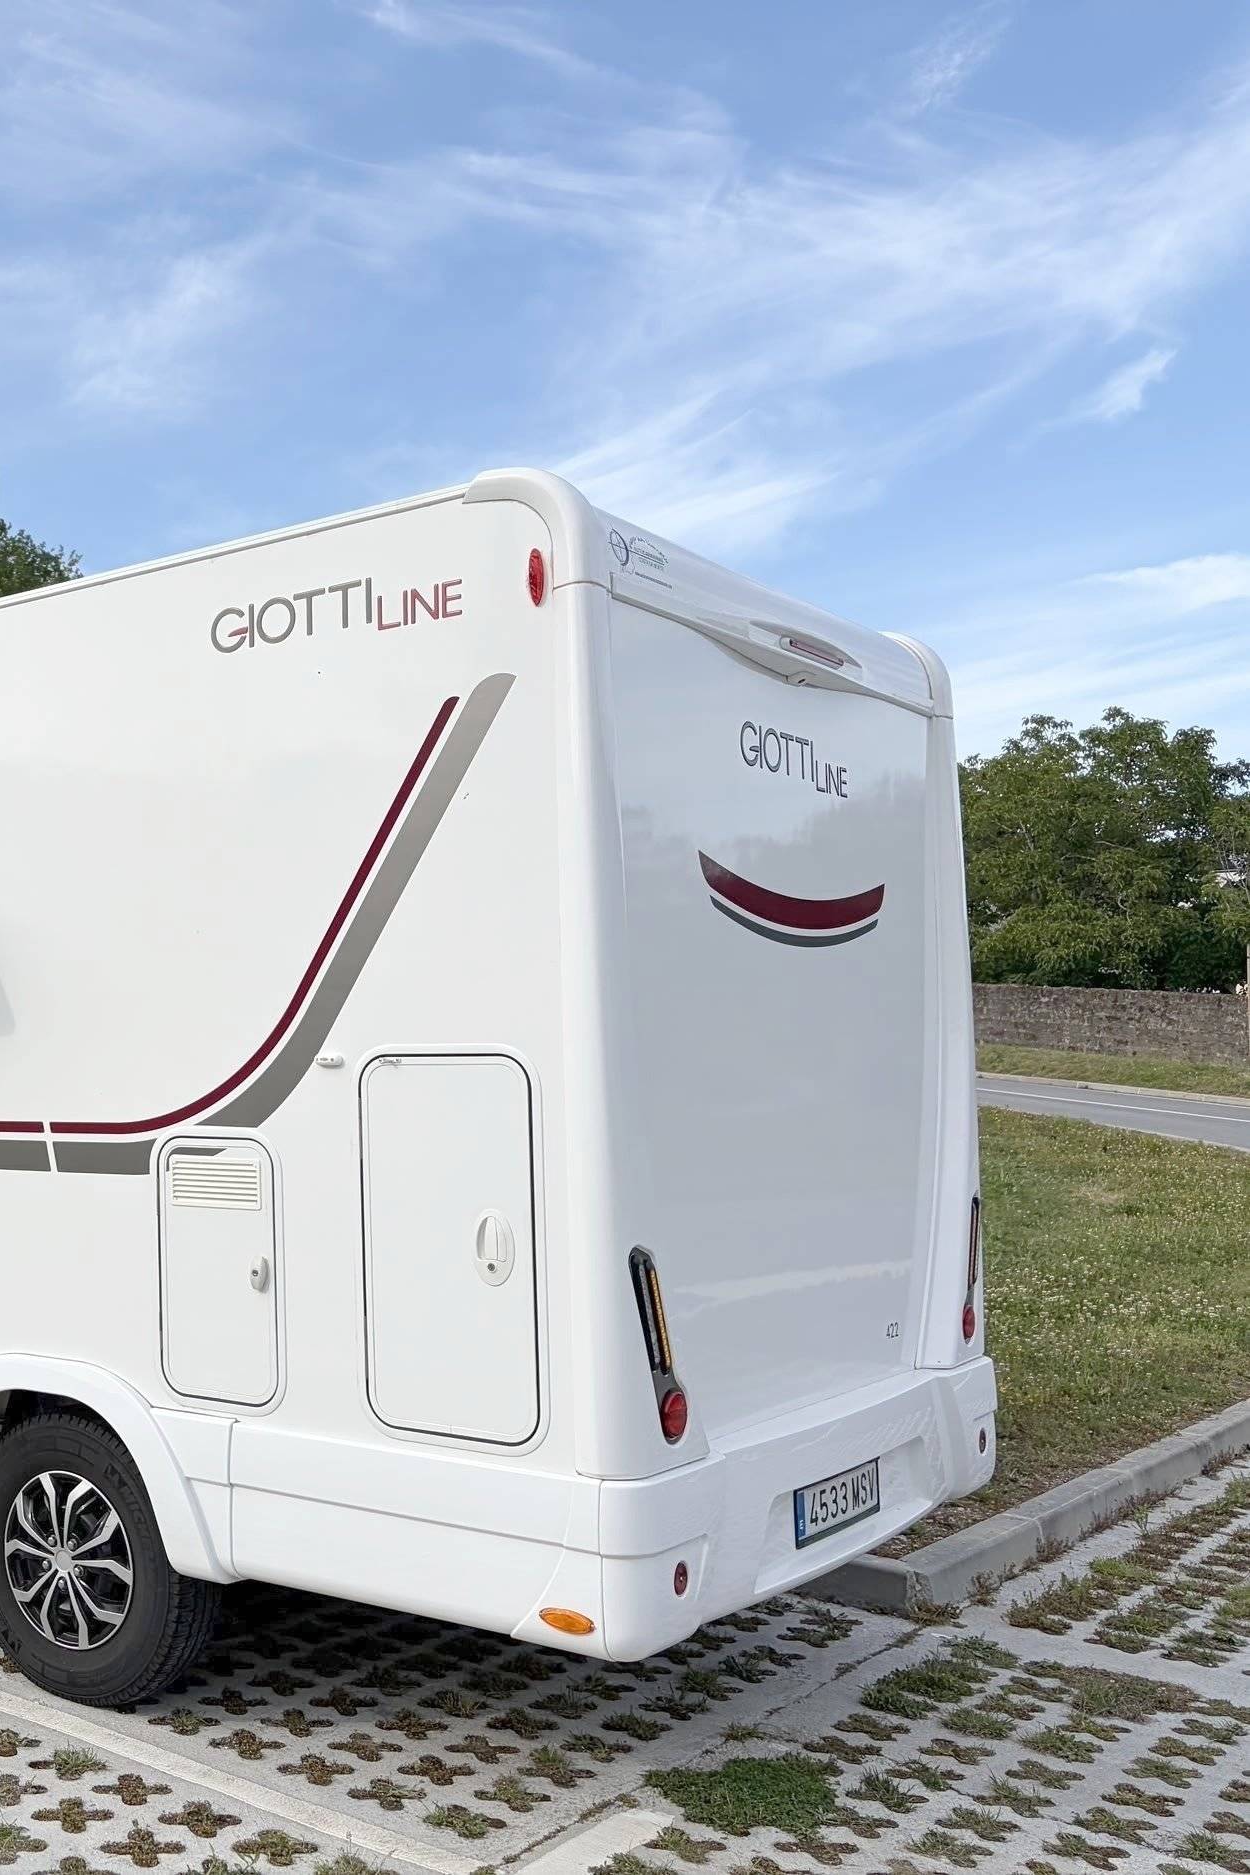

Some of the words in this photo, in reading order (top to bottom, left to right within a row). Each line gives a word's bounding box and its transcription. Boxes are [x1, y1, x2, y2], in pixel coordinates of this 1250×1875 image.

[886, 1321, 899, 1338] 422
[810, 1482, 849, 1526] 4533
[851, 1467, 875, 1510] MSV
